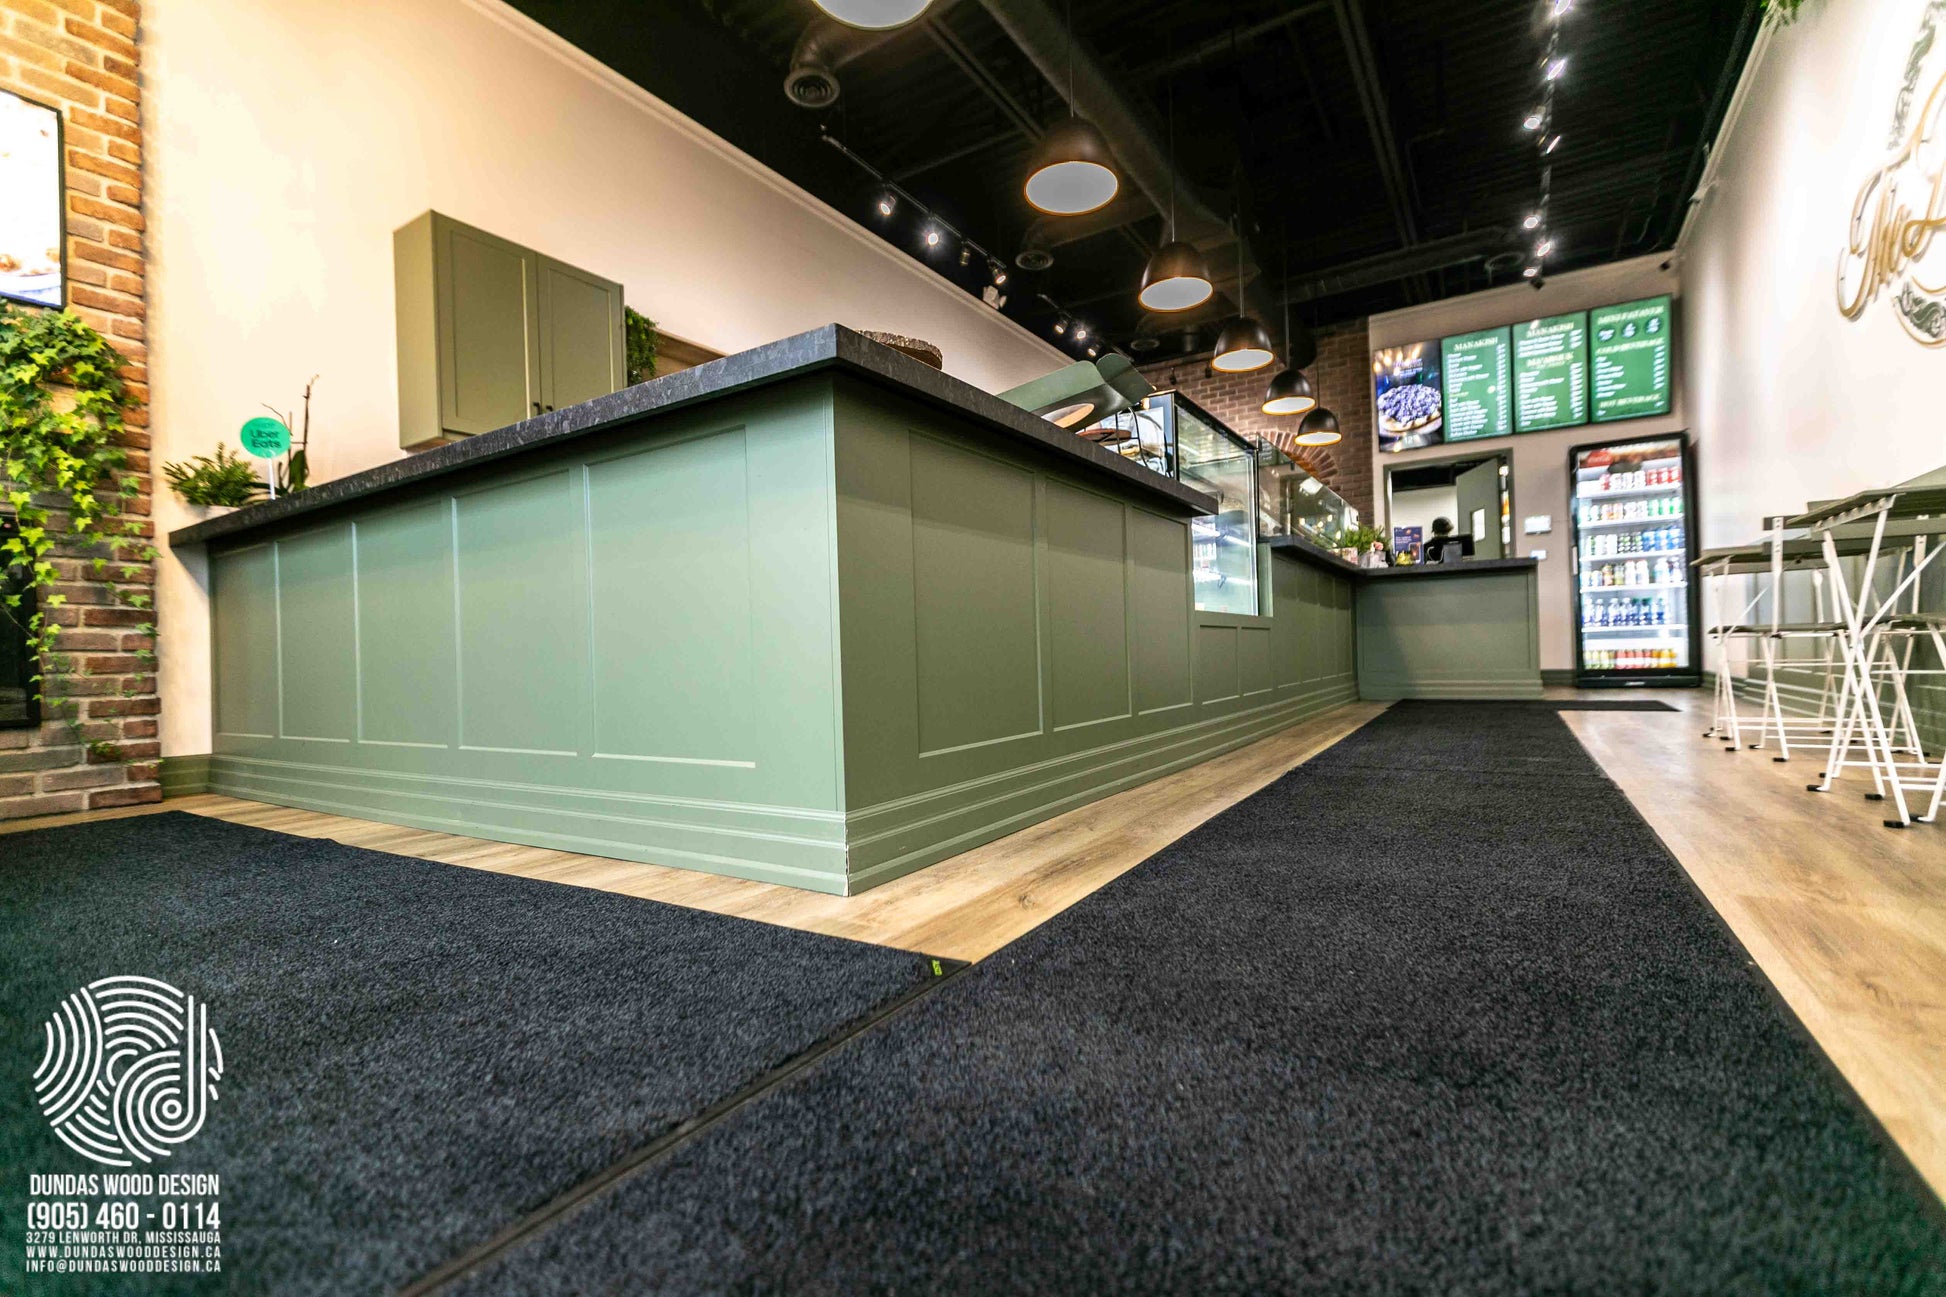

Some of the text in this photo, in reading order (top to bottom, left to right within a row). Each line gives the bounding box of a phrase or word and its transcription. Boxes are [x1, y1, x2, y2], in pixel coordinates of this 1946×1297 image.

[1454, 336, 1498, 351] MANAKISH
[250, 429, 280, 439] Uber
[251, 439, 282, 449] Eats
